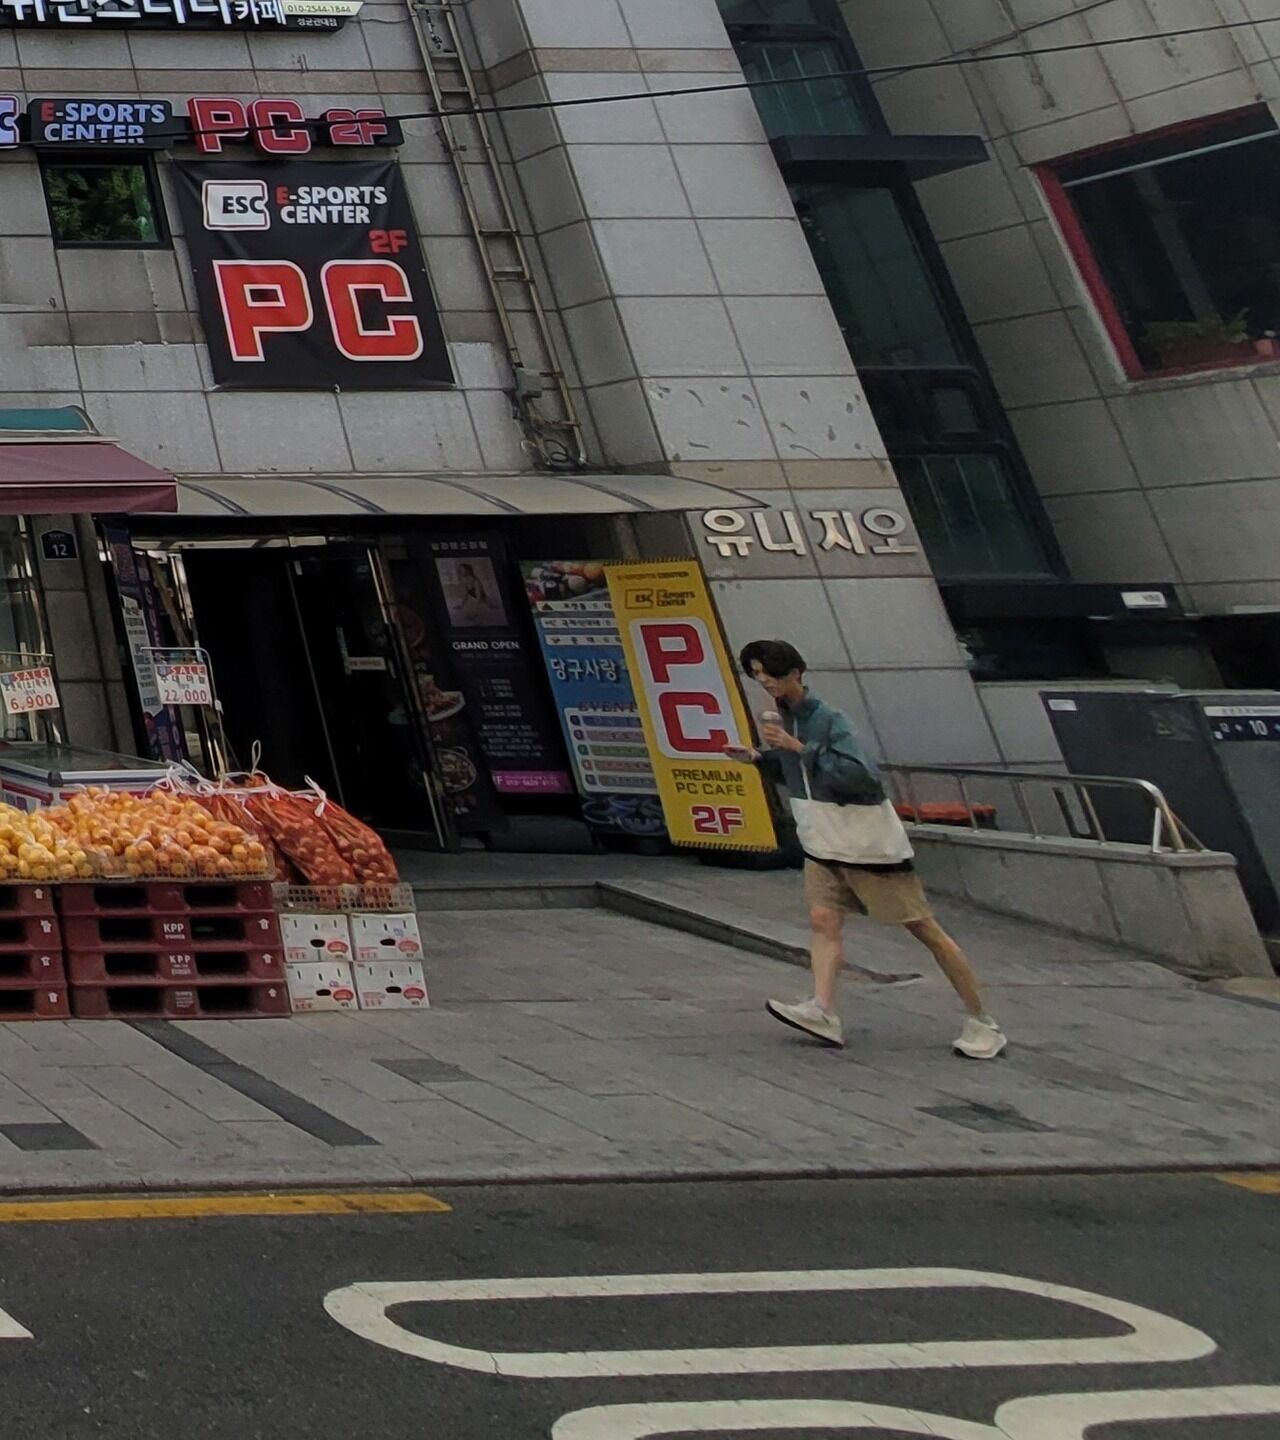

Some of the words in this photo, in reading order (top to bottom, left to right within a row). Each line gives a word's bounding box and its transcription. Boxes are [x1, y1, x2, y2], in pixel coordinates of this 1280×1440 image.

[40, 101, 166, 125] E-SPORTS
[43, 123, 145, 145] CENTER
[188, 96, 312, 155] PC
[326, 107, 390, 147] 2F
[221, 195, 267, 215] ESC
[275, 184, 389, 208] E-SPORTS
[280, 205, 372, 225] CENTER
[367, 229, 409, 254] 2F
[212, 258, 425, 362] PC
[51, 543, 69, 558] 12
[451, 640, 489, 651] GRAND
[490, 640, 521, 651] OPEN
[549, 656, 618, 682] 당구사랑
[163, 689, 208, 704] 22,000
[639, 622, 729, 753] PC
[10, 692, 54, 712] 6,900
[1248, 719, 1268, 736] 10
[671, 768, 743, 783] PREMIUM
[675, 782, 697, 794] PC
[702, 783, 746, 797] CAFE
[690, 805, 744, 836] 2F
[162, 922, 186, 935] KPP
[168, 954, 192, 966] KPP
